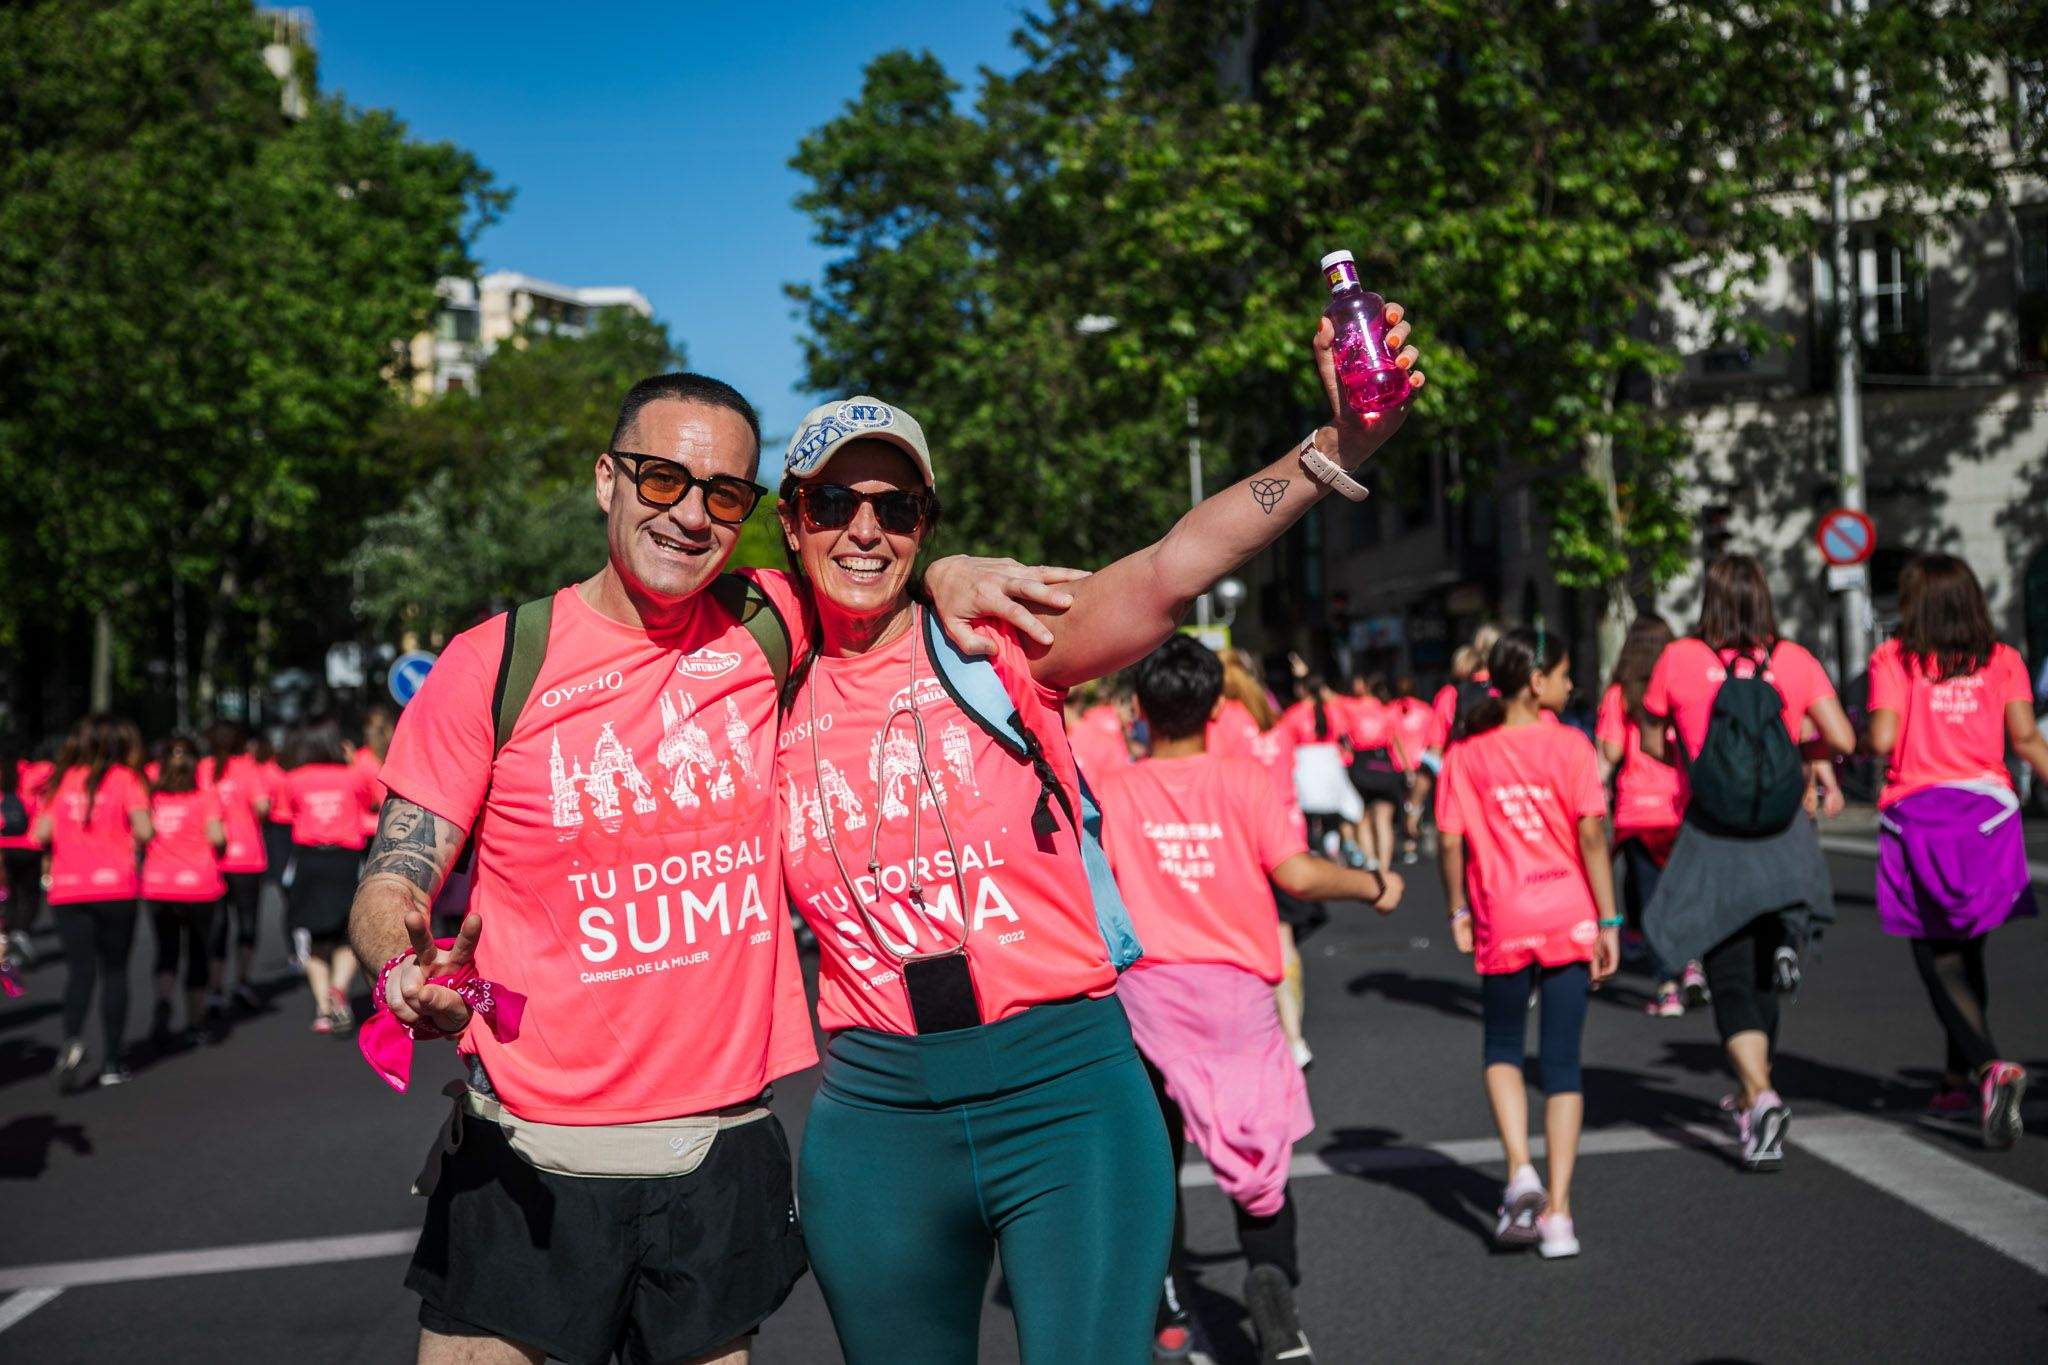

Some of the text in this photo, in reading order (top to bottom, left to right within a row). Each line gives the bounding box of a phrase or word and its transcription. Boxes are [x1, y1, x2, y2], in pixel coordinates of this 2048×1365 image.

[851, 405, 878, 420] NY
[567, 836, 766, 902] TU DORSAL
[807, 840, 1005, 920] TU DORSAL
[578, 873, 769, 963] SUMA
[750, 930, 772, 945] 2022
[835, 876, 1021, 971] SUMA
[998, 930, 1026, 945] 2022
[580, 951, 709, 984] CARRERA DE LA MUJER
